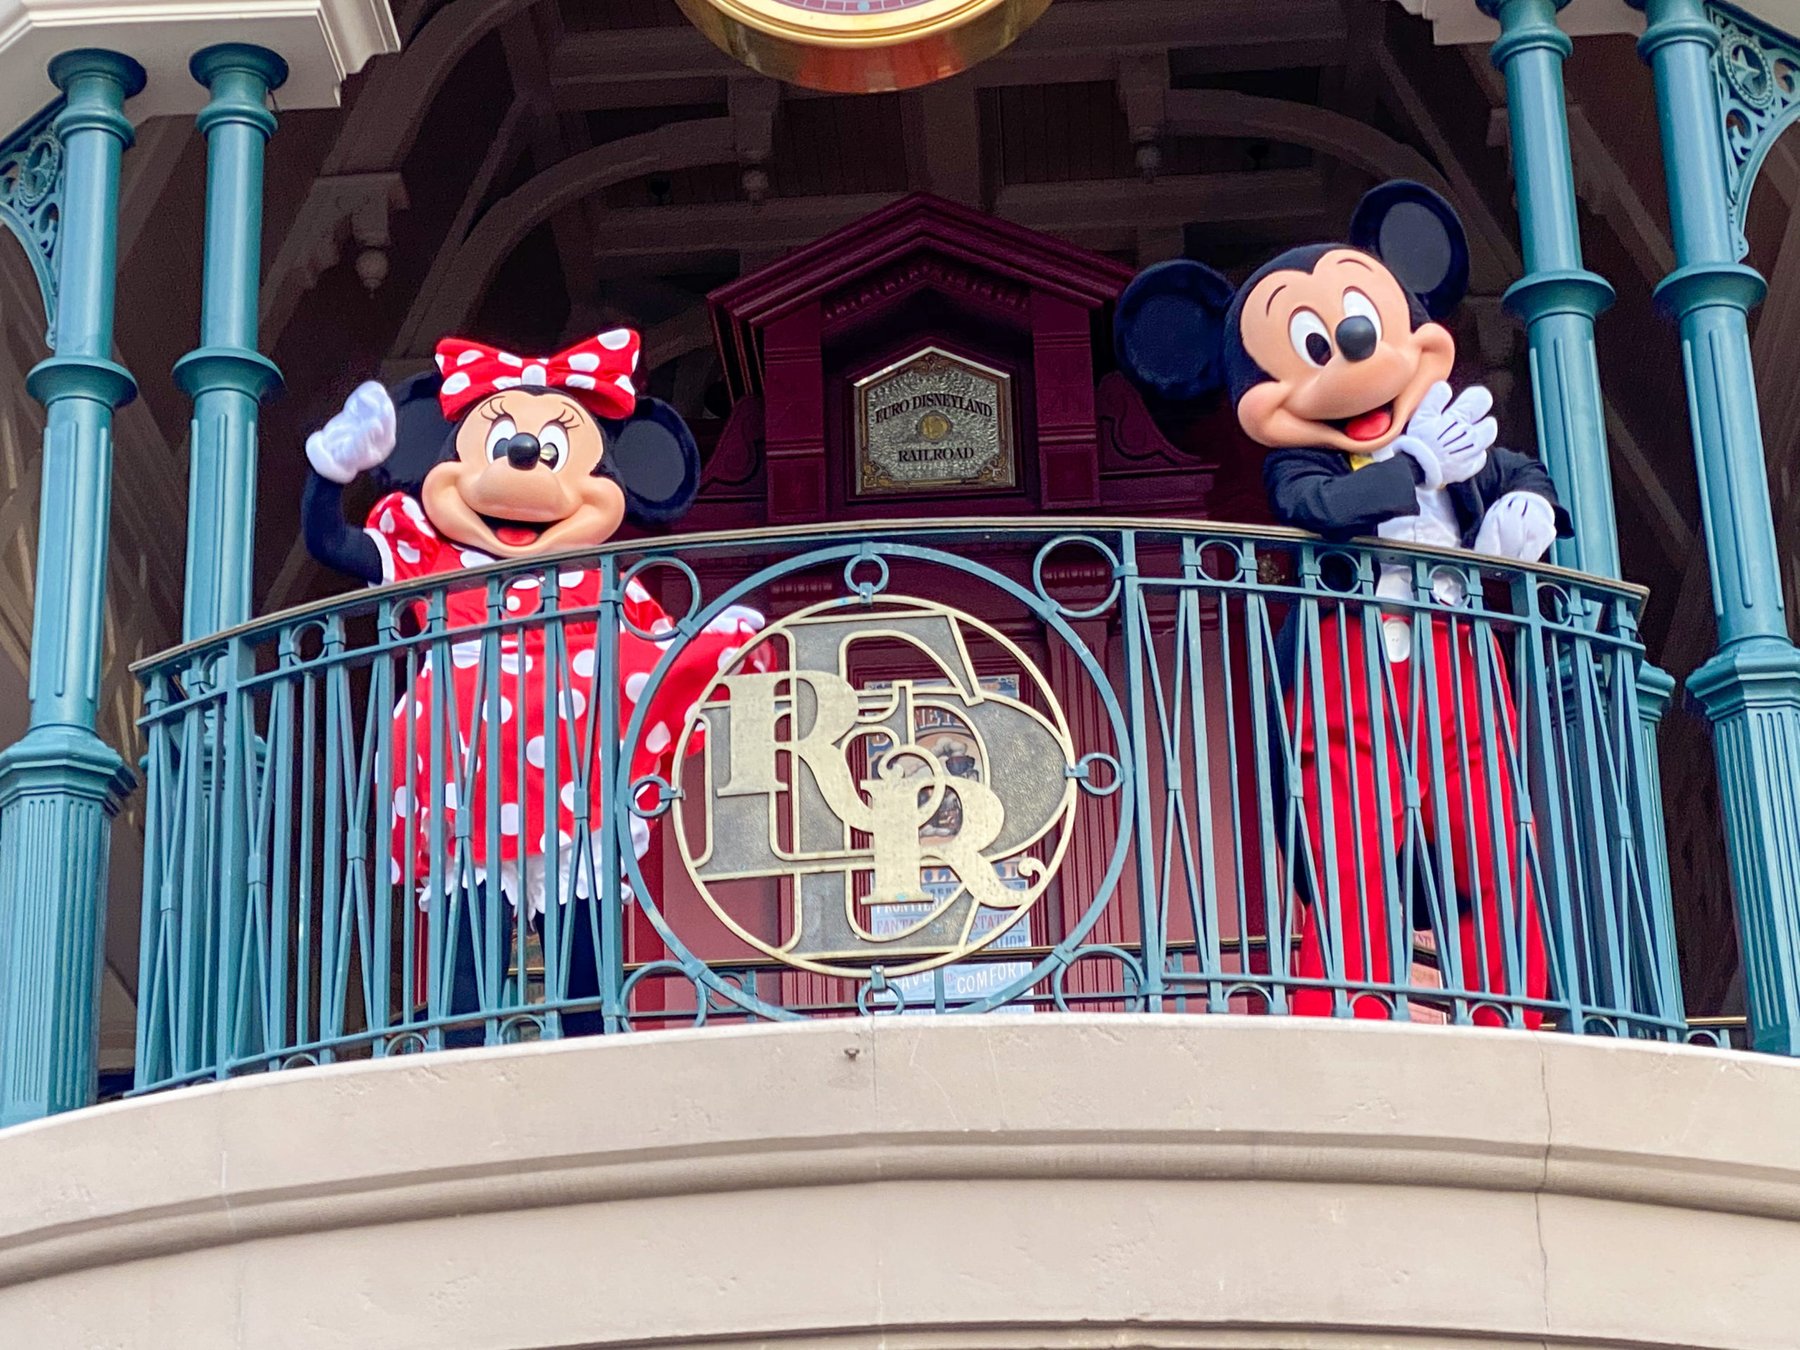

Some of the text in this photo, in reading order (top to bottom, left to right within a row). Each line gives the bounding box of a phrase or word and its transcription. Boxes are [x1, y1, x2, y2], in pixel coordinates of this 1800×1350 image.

[875, 393, 993, 424] EURO DISNEYLAND
[899, 447, 975, 462] RAILROAD
[957, 963, 1025, 994] COMFORT
